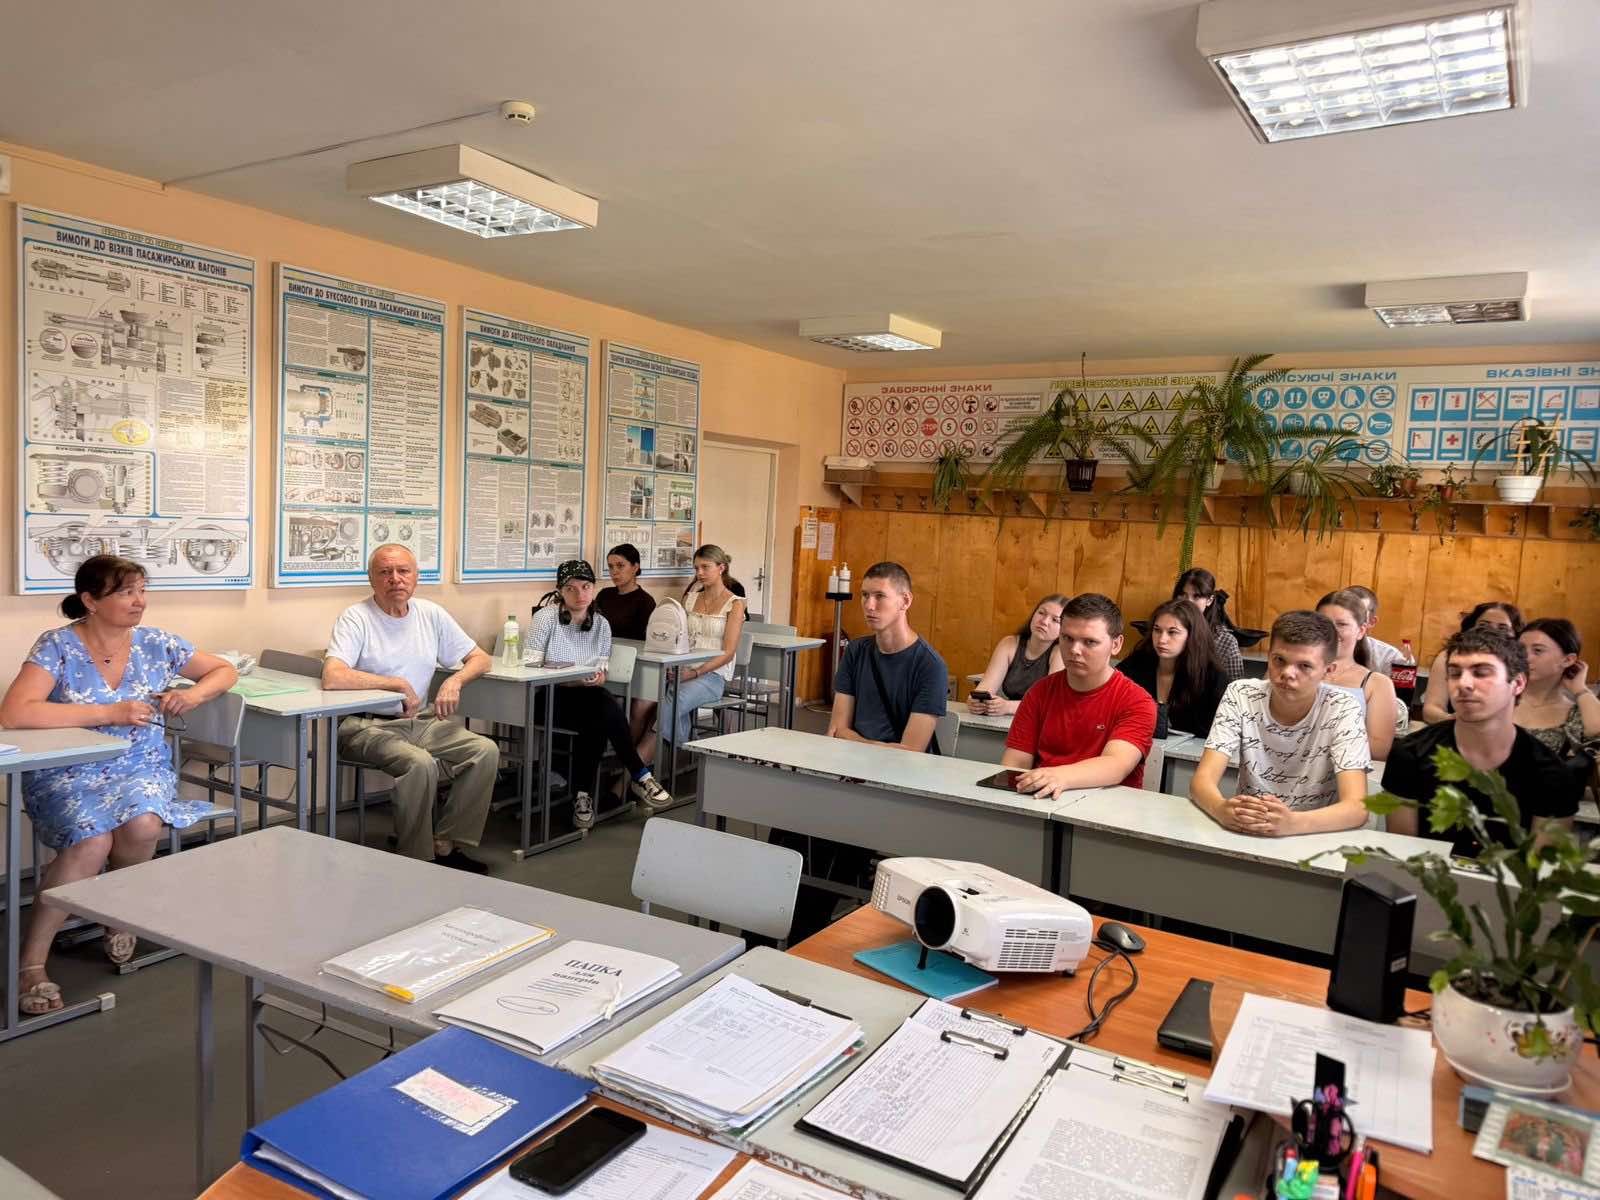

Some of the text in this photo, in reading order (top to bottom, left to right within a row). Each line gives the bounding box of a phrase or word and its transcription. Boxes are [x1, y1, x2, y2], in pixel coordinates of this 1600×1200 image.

[56, 231, 91, 248] ВИМОГИ
[94, 239, 106, 251] ДО
[109, 242, 134, 257] ВІЗКІВ
[136, 248, 196, 270] ПАСАЖИРСЬКИХ
[198, 261, 227, 276] ВАГОНІВ
[288, 282, 313, 297] ВИМОГИ
[315, 288, 324, 298] ДО
[326, 290, 359, 306] БУКСОВОГО
[360, 298, 377, 310] ВУЗЛА
[379, 302, 420, 319] ПАСАЖИРСЬКИХ
[421, 311, 442, 323] ВАГОНІВ
[480, 325, 501, 337] ВИМОГИ
[502, 329, 510, 338] ДО
[1239, 371, 1397, 383] РИПИСУЮЧІ ЗНАКИ
[1487, 366, 1570, 378] ВКАЗІВНІ
[881, 384, 992, 394] ЗАБОРОННІ ЗНАКИ
[946, 422, 952, 431] 5
[965, 422, 973, 431] 10
[565, 959, 622, 976] ПАПКА
